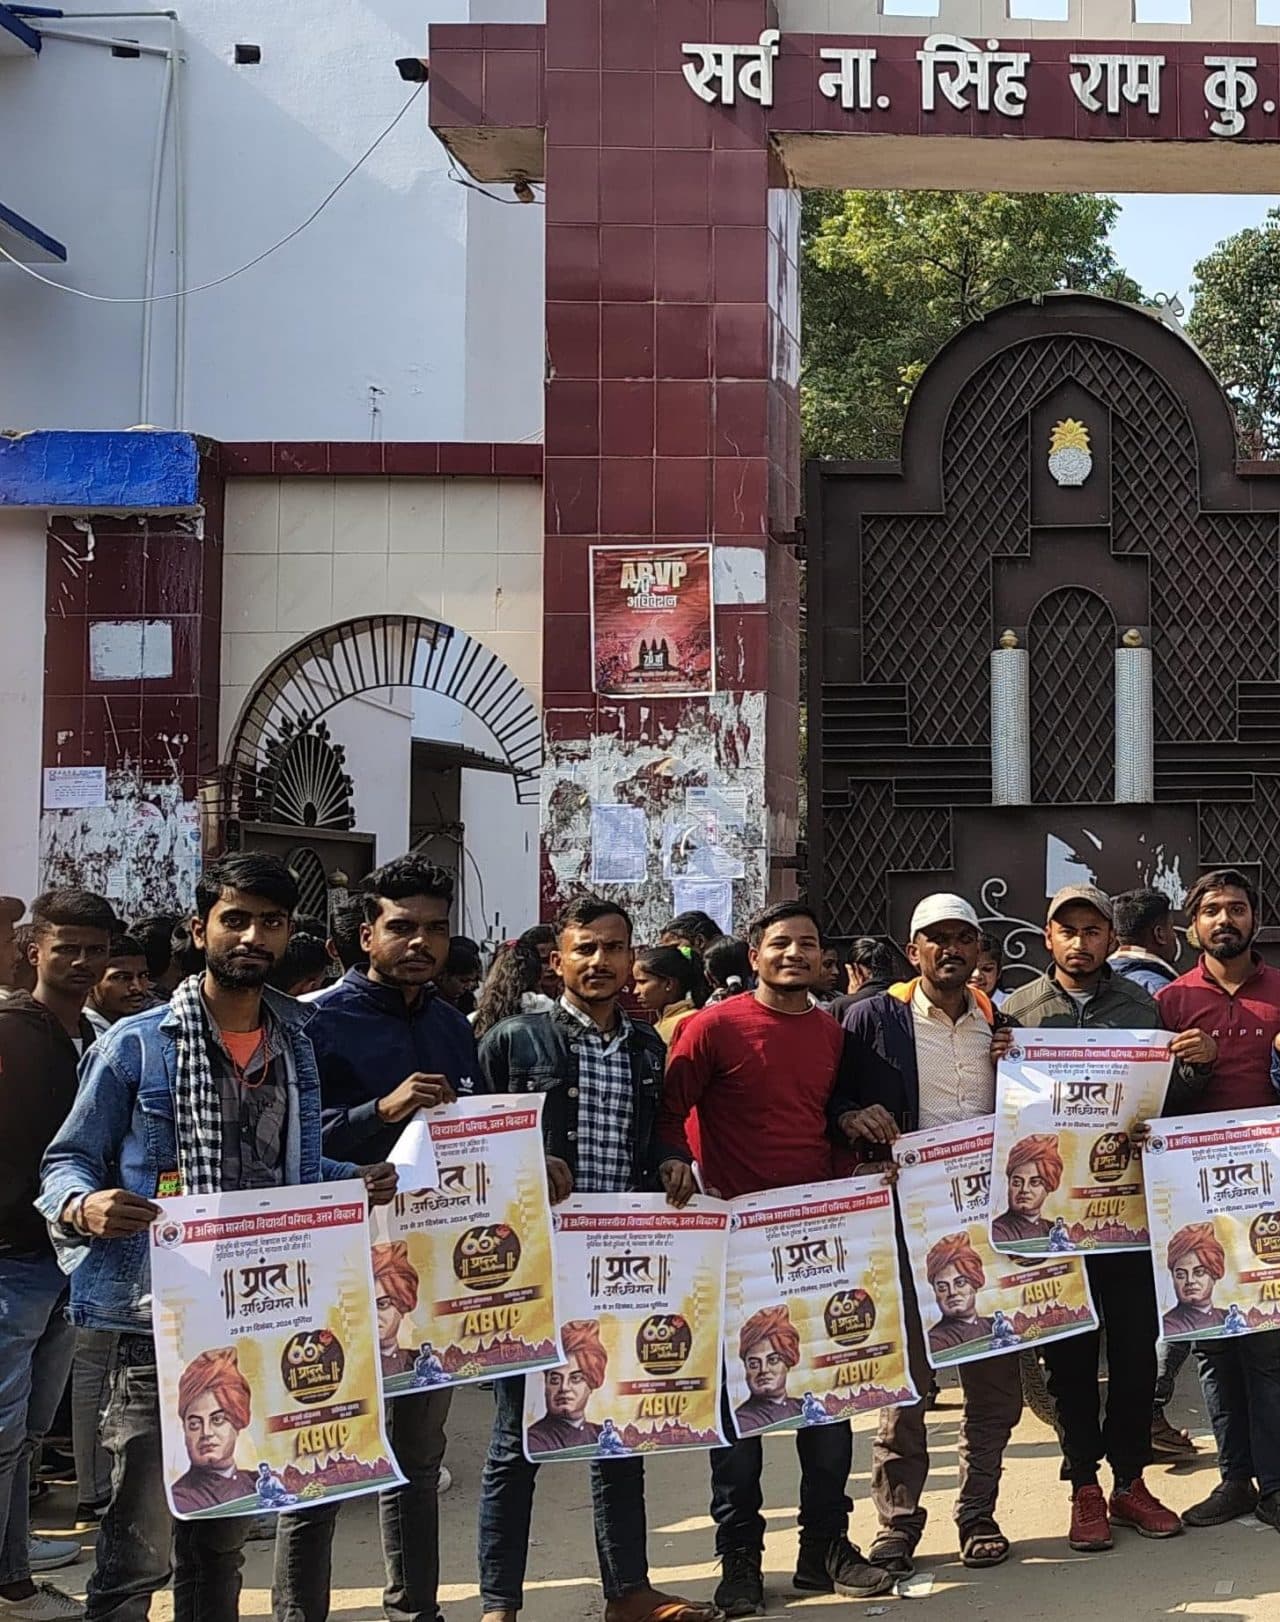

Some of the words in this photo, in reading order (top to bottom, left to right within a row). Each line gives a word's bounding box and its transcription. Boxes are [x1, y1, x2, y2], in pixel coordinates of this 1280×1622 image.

[681, 30, 781, 106] सर्व
[819, 48, 891, 109] ना.
[916, 33, 1031, 117] सिंह
[1068, 54, 1165, 115] राम
[1203, 56, 1276, 137] कु.
[1066, 1076, 1109, 1104] प्रांत
[1212, 1159, 1259, 1188] प्रांत
[604, 1249, 654, 1281] प्रांत
[786, 1236, 836, 1267] प्रांत
[239, 1257, 295, 1297] प्रांत
[1024, 1280, 1063, 1305] ABVP
[464, 1307, 521, 1336] ABVP
[838, 1361, 880, 1385] ABVP
[641, 1395, 689, 1417] ABVP
[298, 1423, 349, 1455] ABVP
